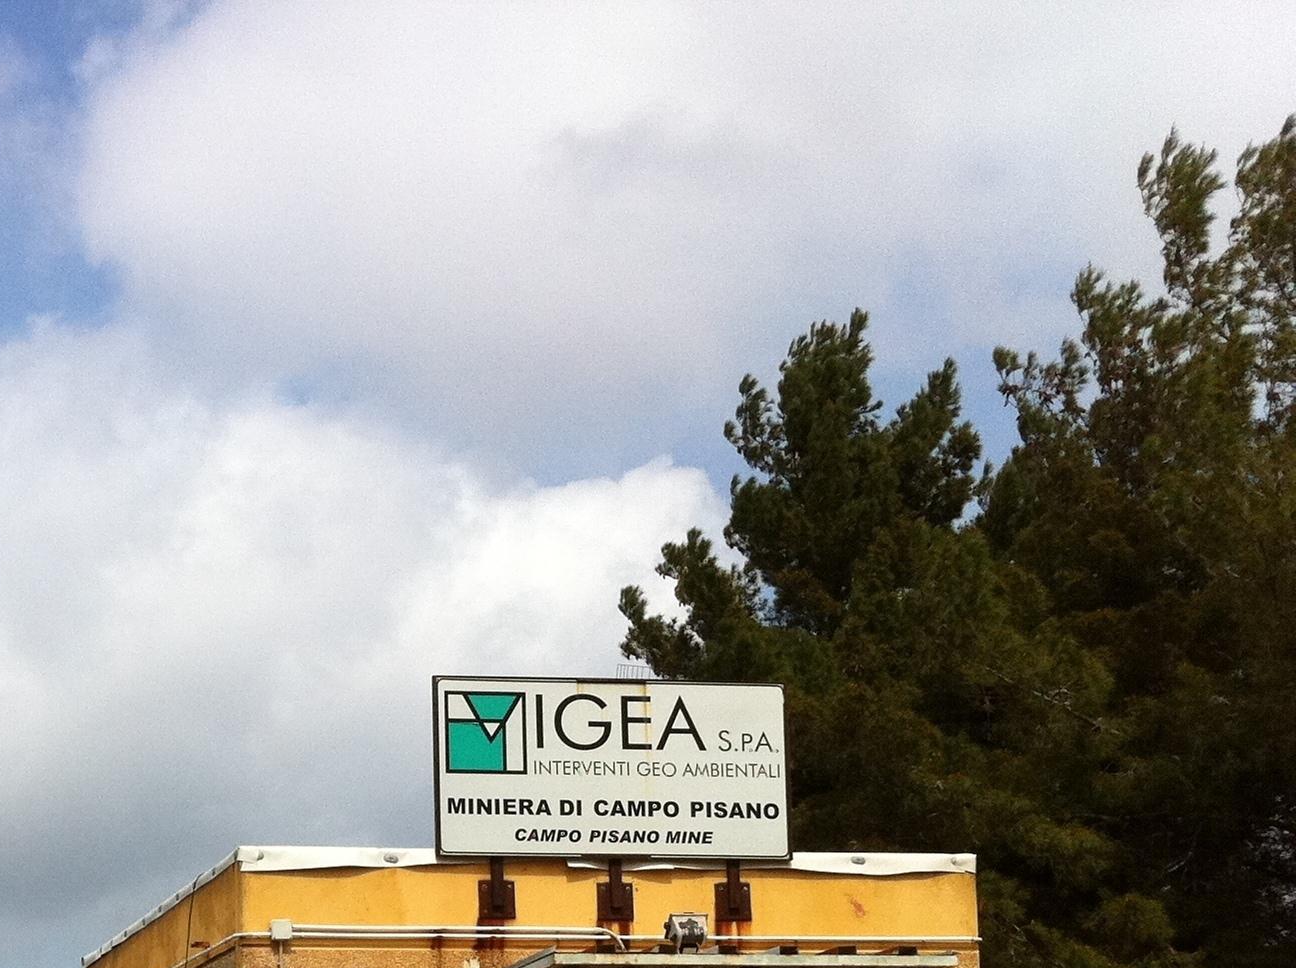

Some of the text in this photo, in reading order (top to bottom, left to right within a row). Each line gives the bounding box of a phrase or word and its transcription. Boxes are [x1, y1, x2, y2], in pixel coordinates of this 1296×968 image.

[536, 694, 707, 751] IGEA
[534, 760, 781, 778] INTERVENTI GEO AMBIENTALI
[447, 798, 780, 819] MINIERA DI CAMPO PISANO
[515, 829, 713, 844] CAMPO PISANO MINE
